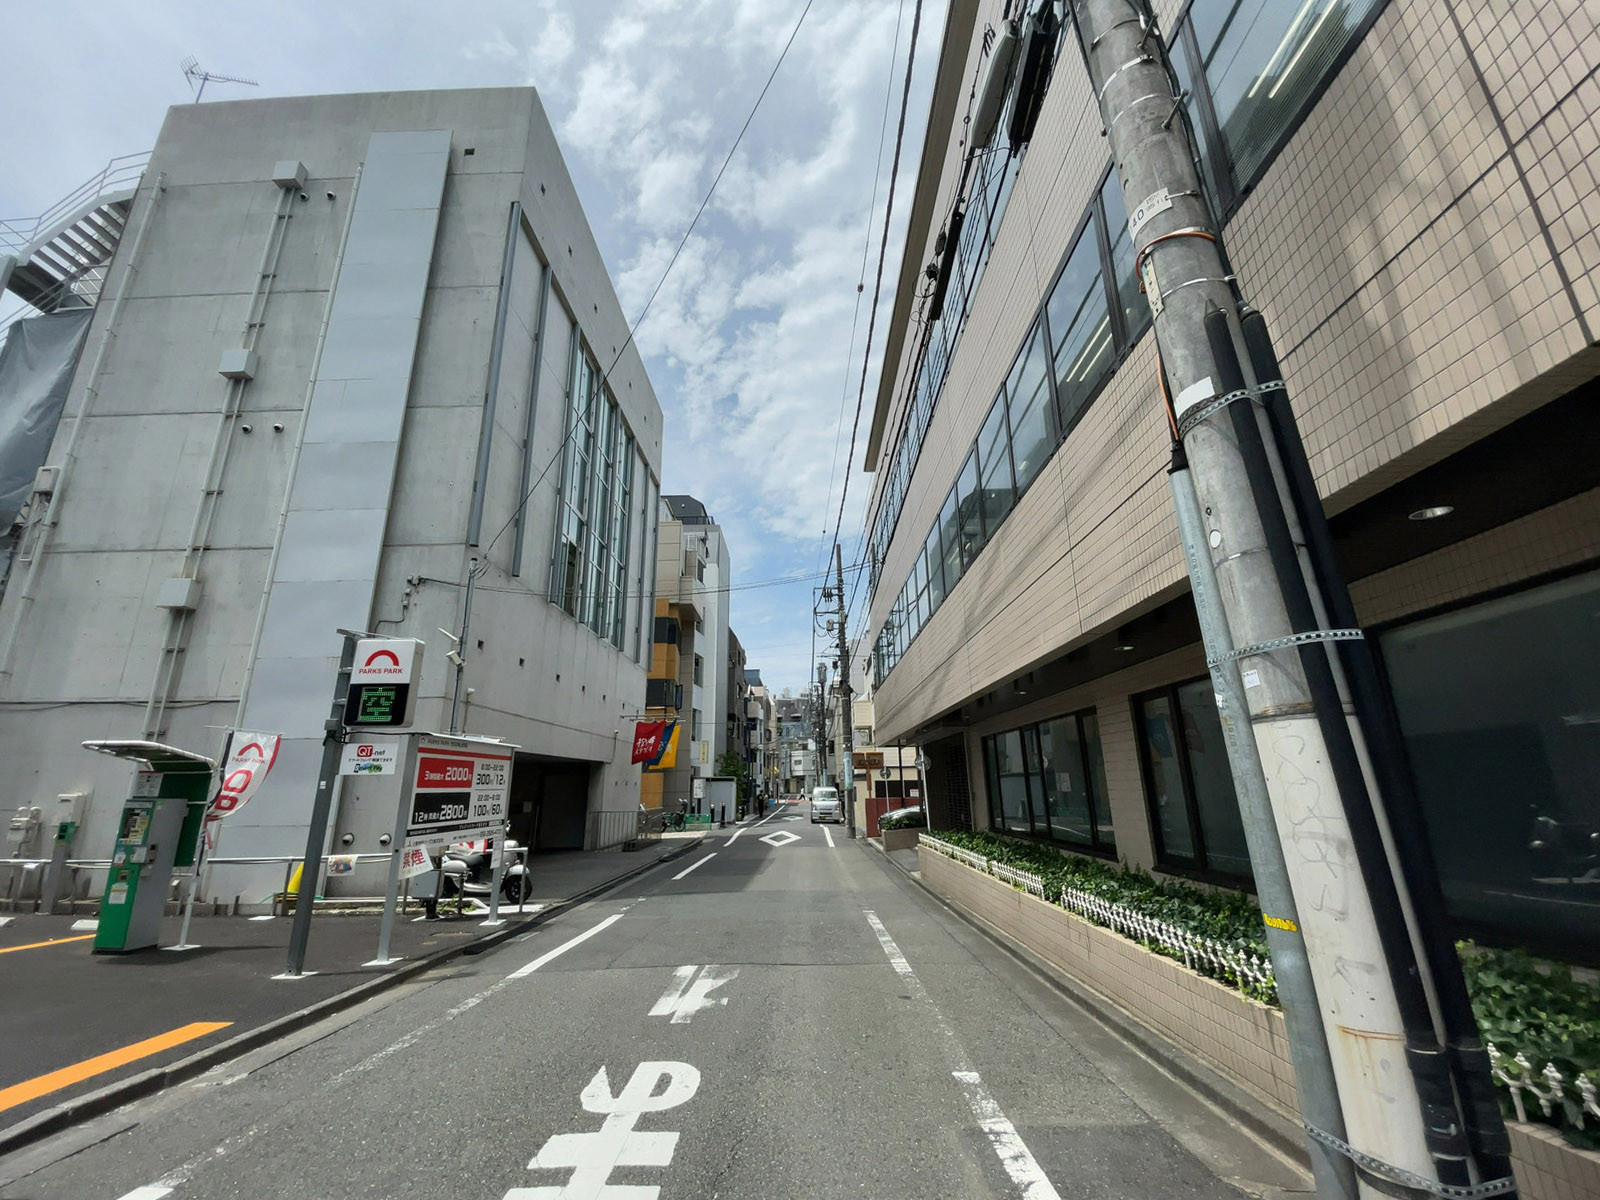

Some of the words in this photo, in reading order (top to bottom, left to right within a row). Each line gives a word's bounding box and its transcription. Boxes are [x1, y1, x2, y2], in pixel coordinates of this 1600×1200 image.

[358, 667, 382, 675] PARKS
[360, 687, 396, 722] 空
[357, 745, 386, 757] QT-net
